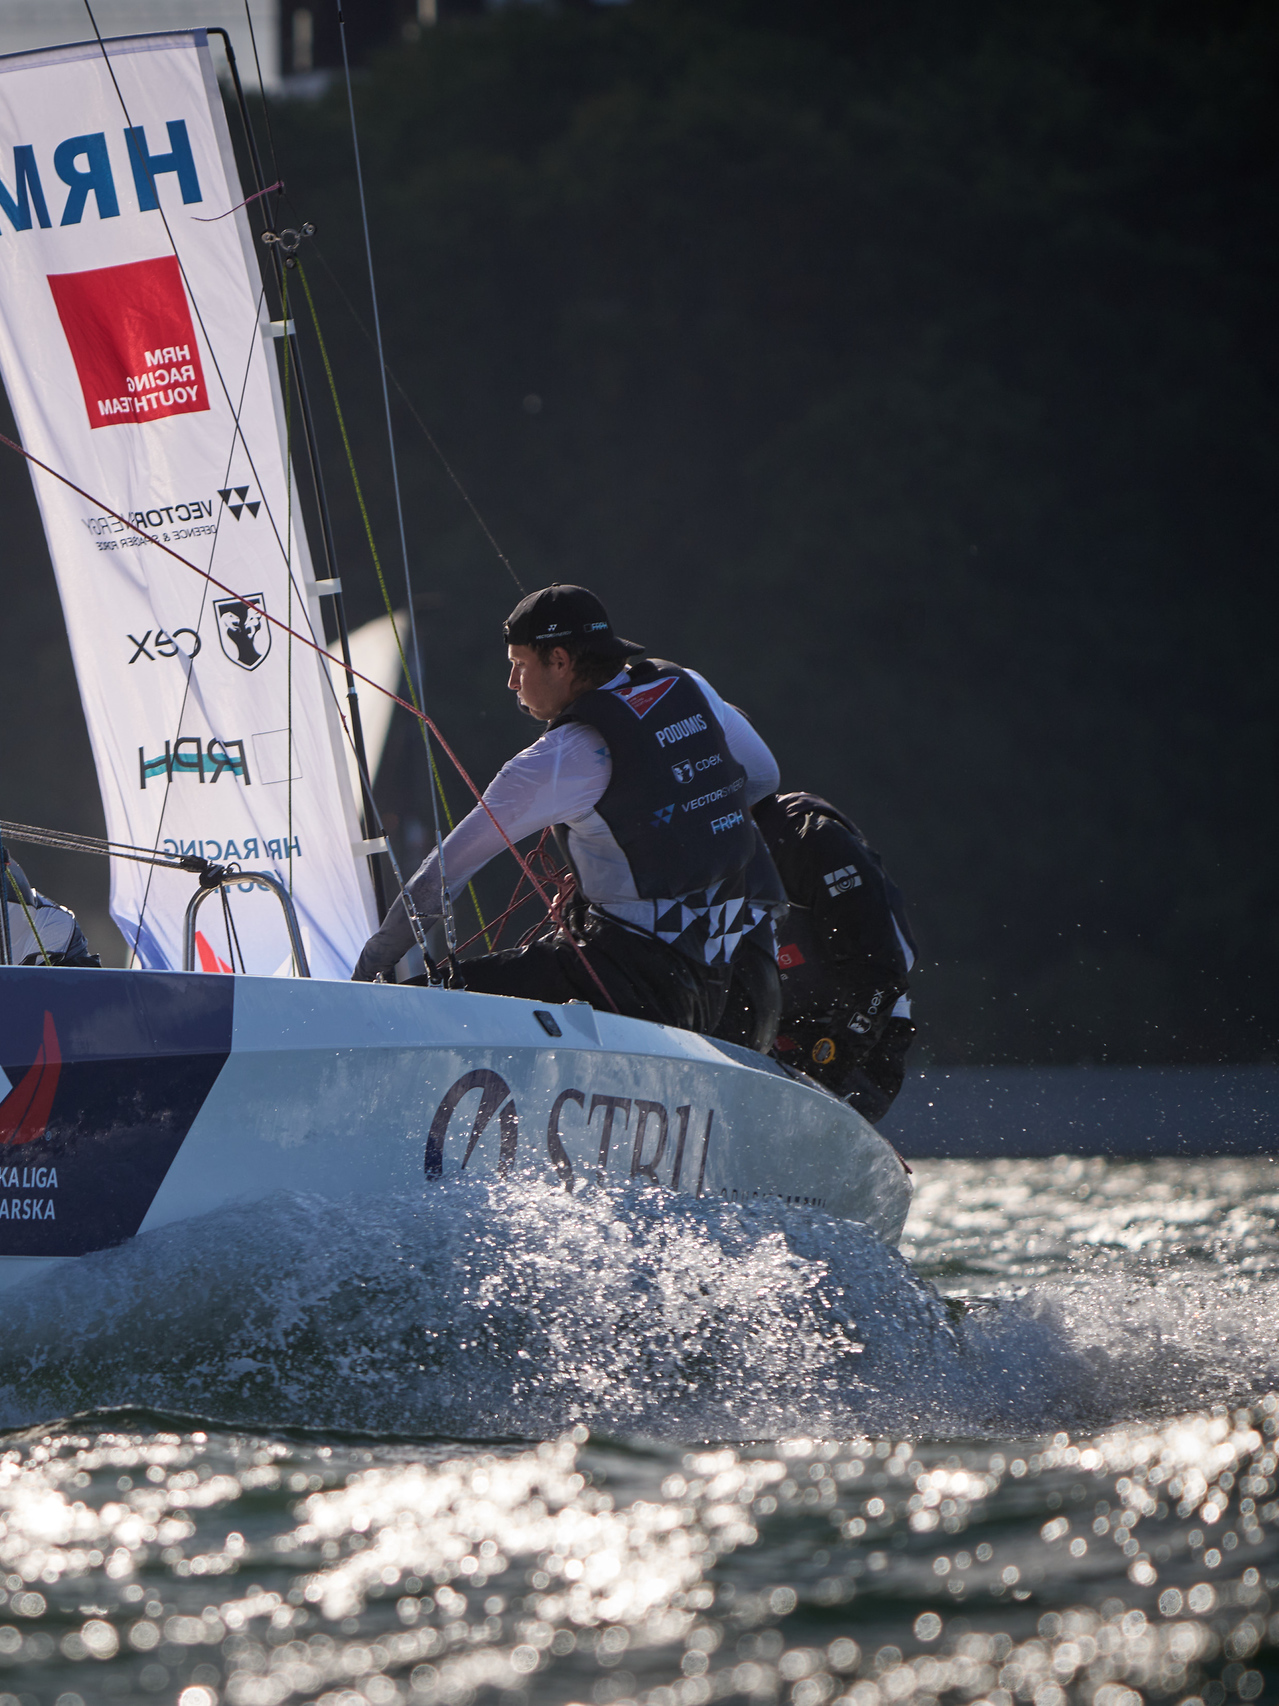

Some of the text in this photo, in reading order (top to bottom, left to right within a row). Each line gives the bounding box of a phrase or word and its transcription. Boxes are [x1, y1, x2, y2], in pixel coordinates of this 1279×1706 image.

[655, 713, 707, 748] PODUMIS
[710, 809, 745, 835] FRPH
[22, 1166, 59, 1189] LIGA
